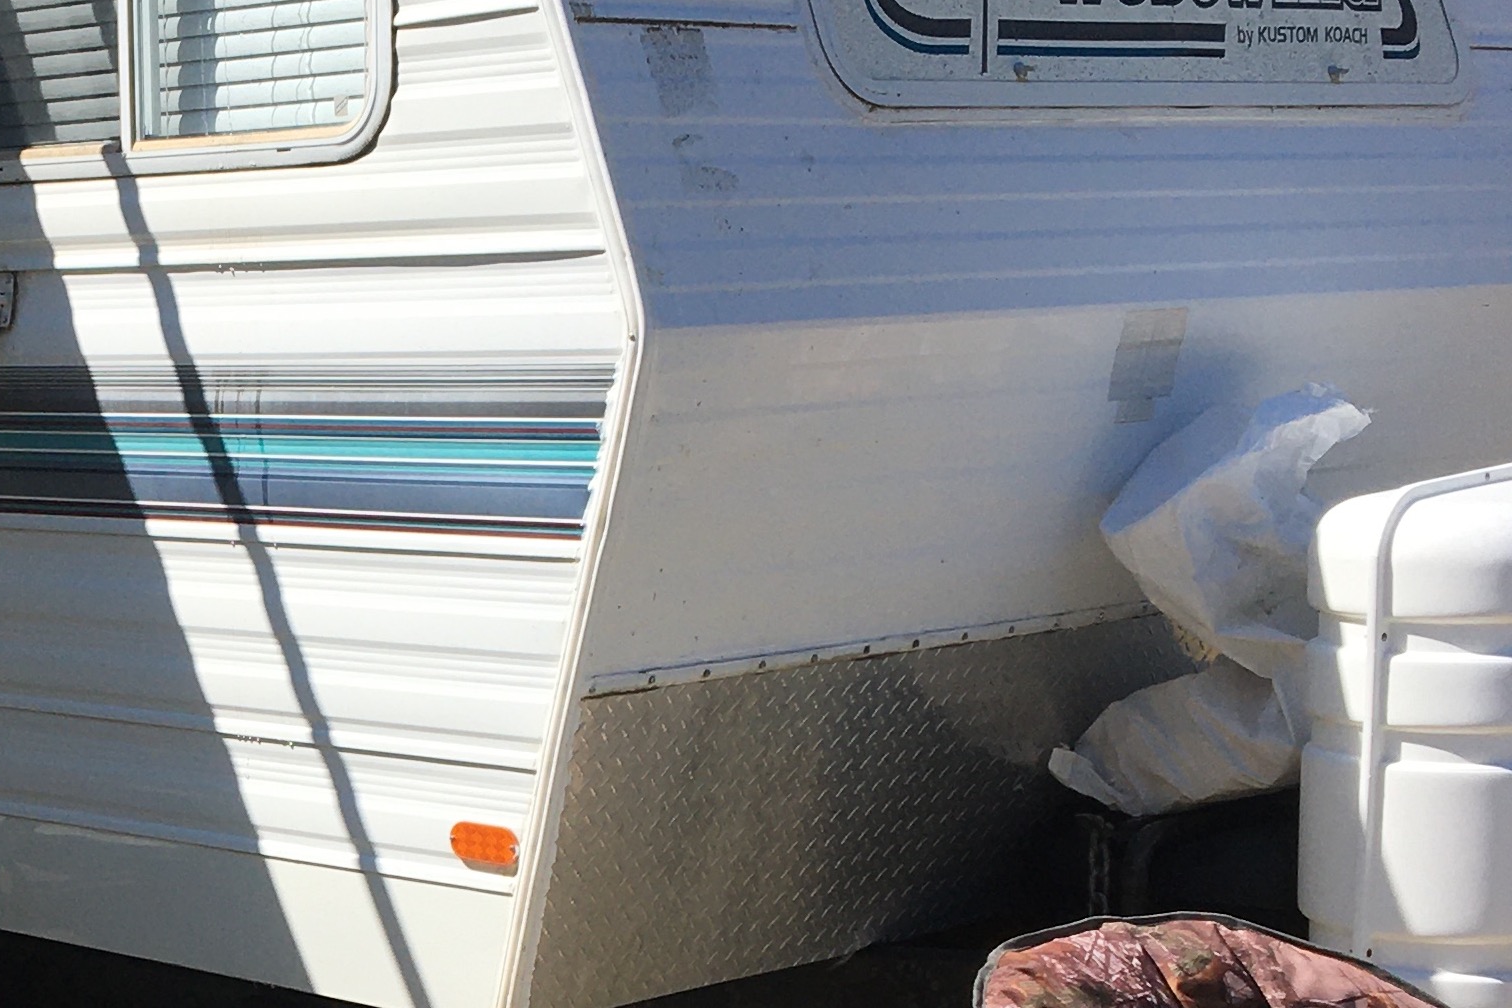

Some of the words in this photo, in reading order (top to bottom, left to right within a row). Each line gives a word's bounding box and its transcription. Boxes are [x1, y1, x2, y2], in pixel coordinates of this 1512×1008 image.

[1237, 24, 1254, 49] by
[1258, 25, 1318, 43] KUSTOM
[1325, 25, 1368, 44] KOACH
